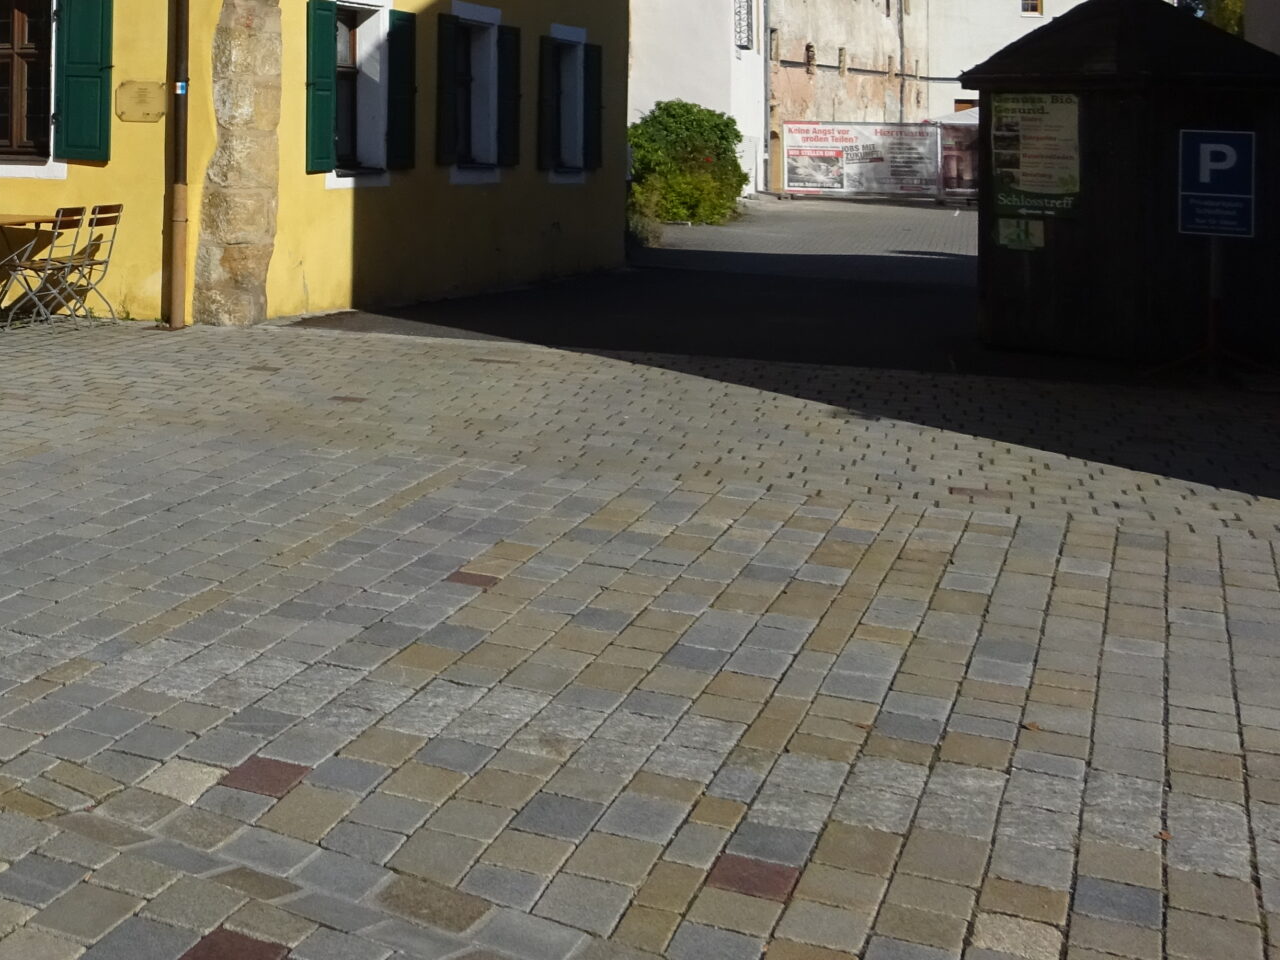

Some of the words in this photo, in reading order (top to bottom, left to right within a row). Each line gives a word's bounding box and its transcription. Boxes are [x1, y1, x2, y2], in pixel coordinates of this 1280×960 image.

[788, 127, 810, 135] Keine
[812, 127, 836, 136] Angst
[837, 128, 850, 136] vor
[1199, 143, 1238, 183] P
[998, 192, 1074, 208] Schlosstreff
